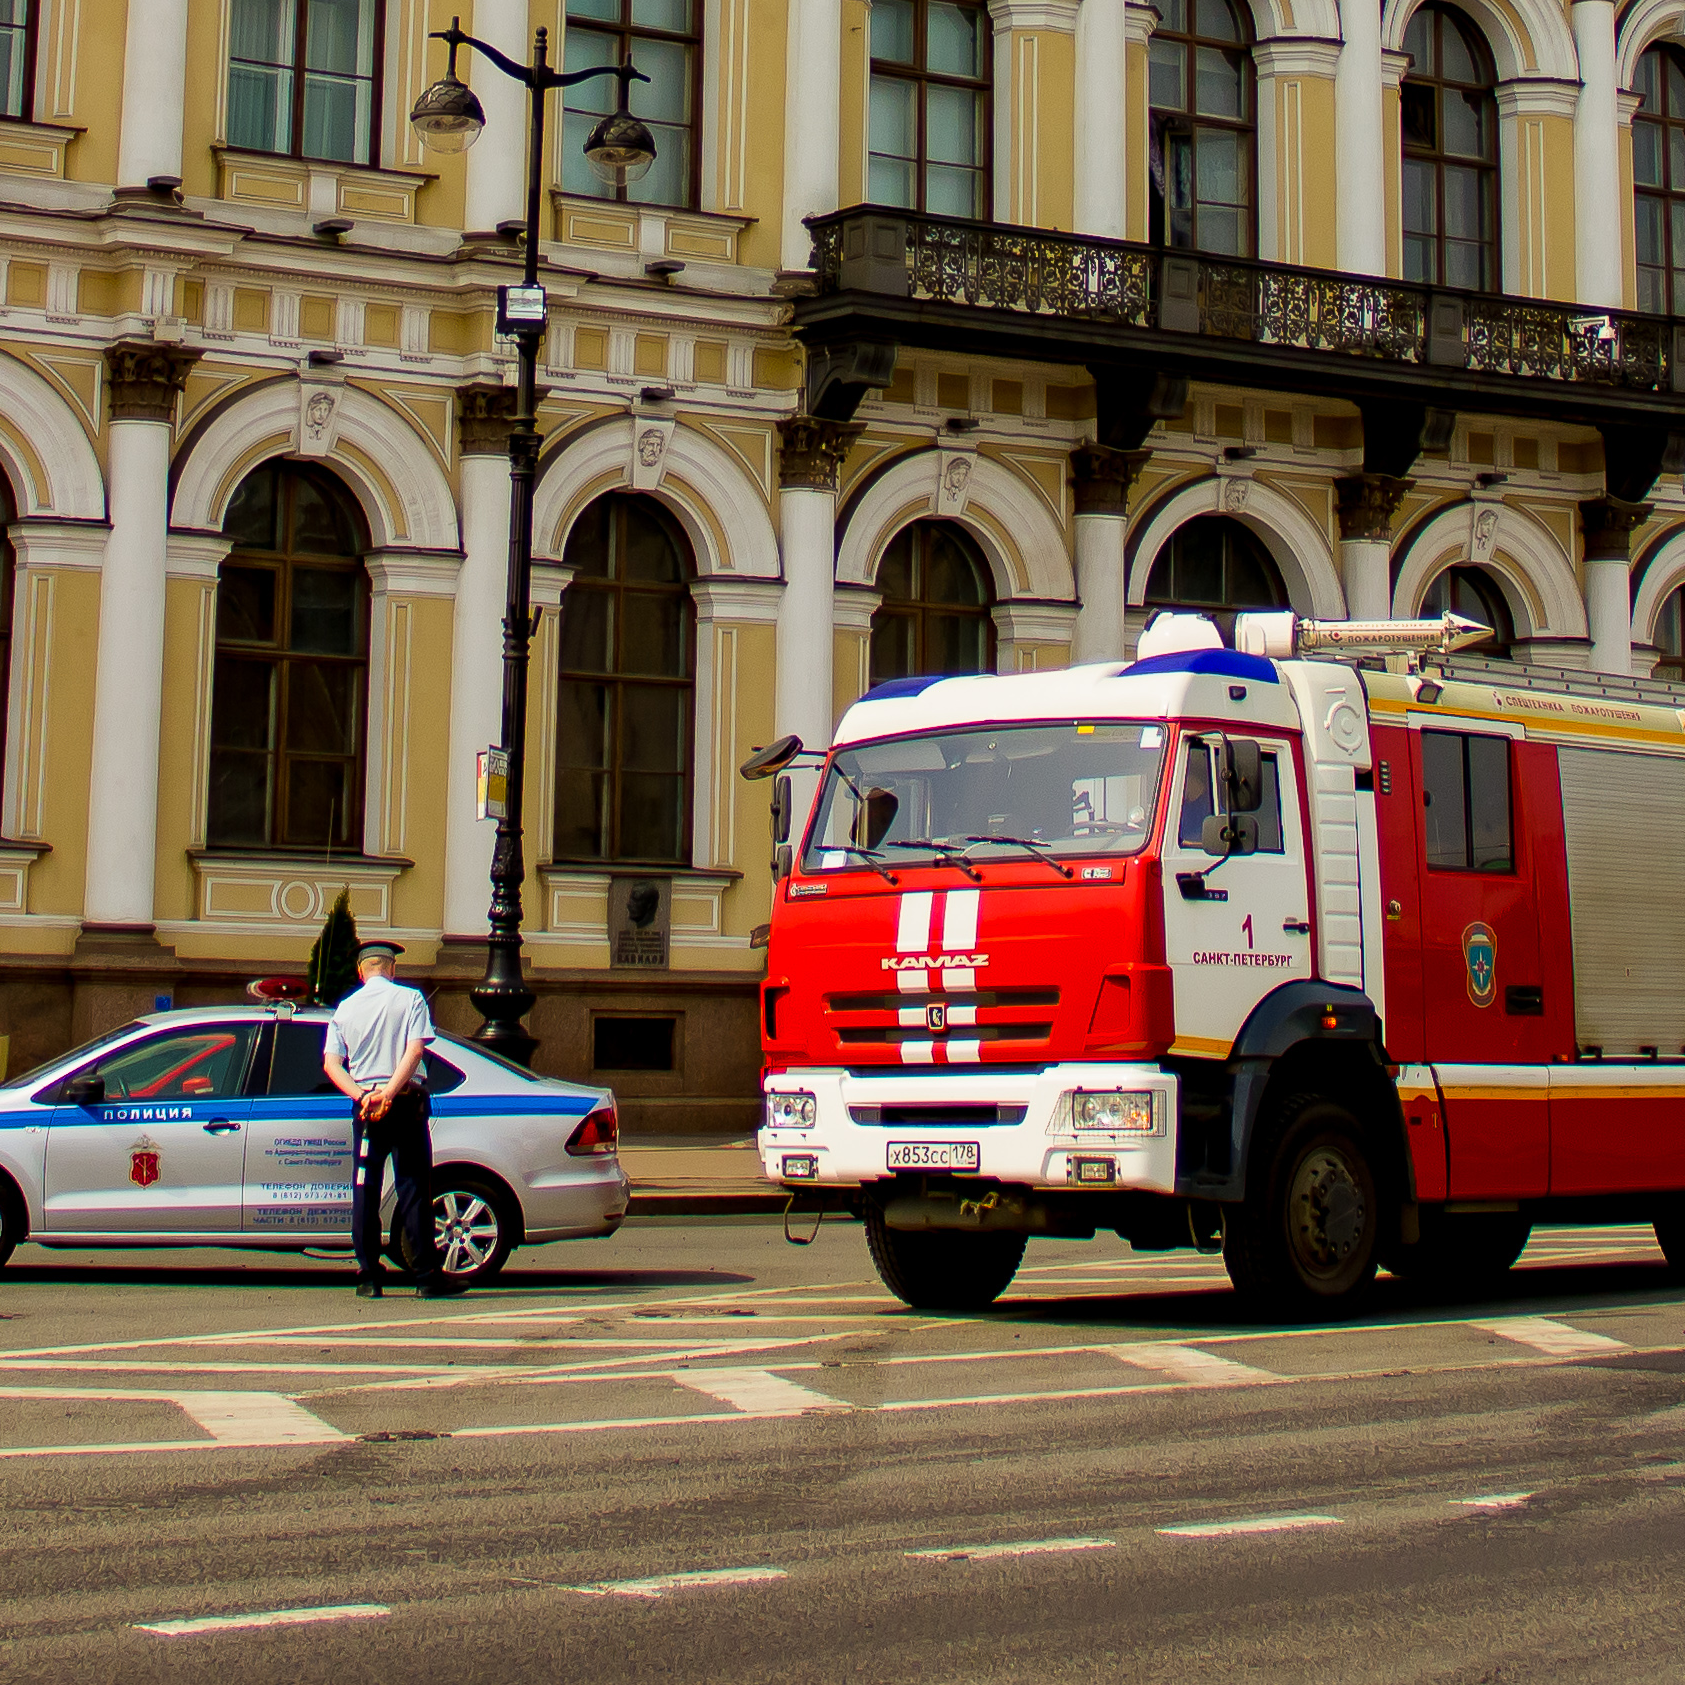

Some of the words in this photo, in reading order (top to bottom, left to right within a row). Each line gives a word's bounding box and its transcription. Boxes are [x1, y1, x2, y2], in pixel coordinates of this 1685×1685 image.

[1347, 633, 1435, 644] ПОЖАРОТУШЕНИЯ
[1505, 696, 1565, 712] СПЕЦТЕХНИКА
[1570, 703, 1641, 721] ПОЖАРОТУШЕНИЯ
[1242, 914, 1254, 949] 1
[881, 954, 989, 970] KAMAZ
[1193, 951, 1293, 967] САНКТ-ПЕТЕРБУРГ
[103, 1107, 193, 1121] ПОЛИЦИЯ
[952, 1144, 975, 1159] 178
[261, 1183, 306, 1191] ТЕЛЕФОН
[257, 1207, 302, 1216] ТЕЛЕФОН
